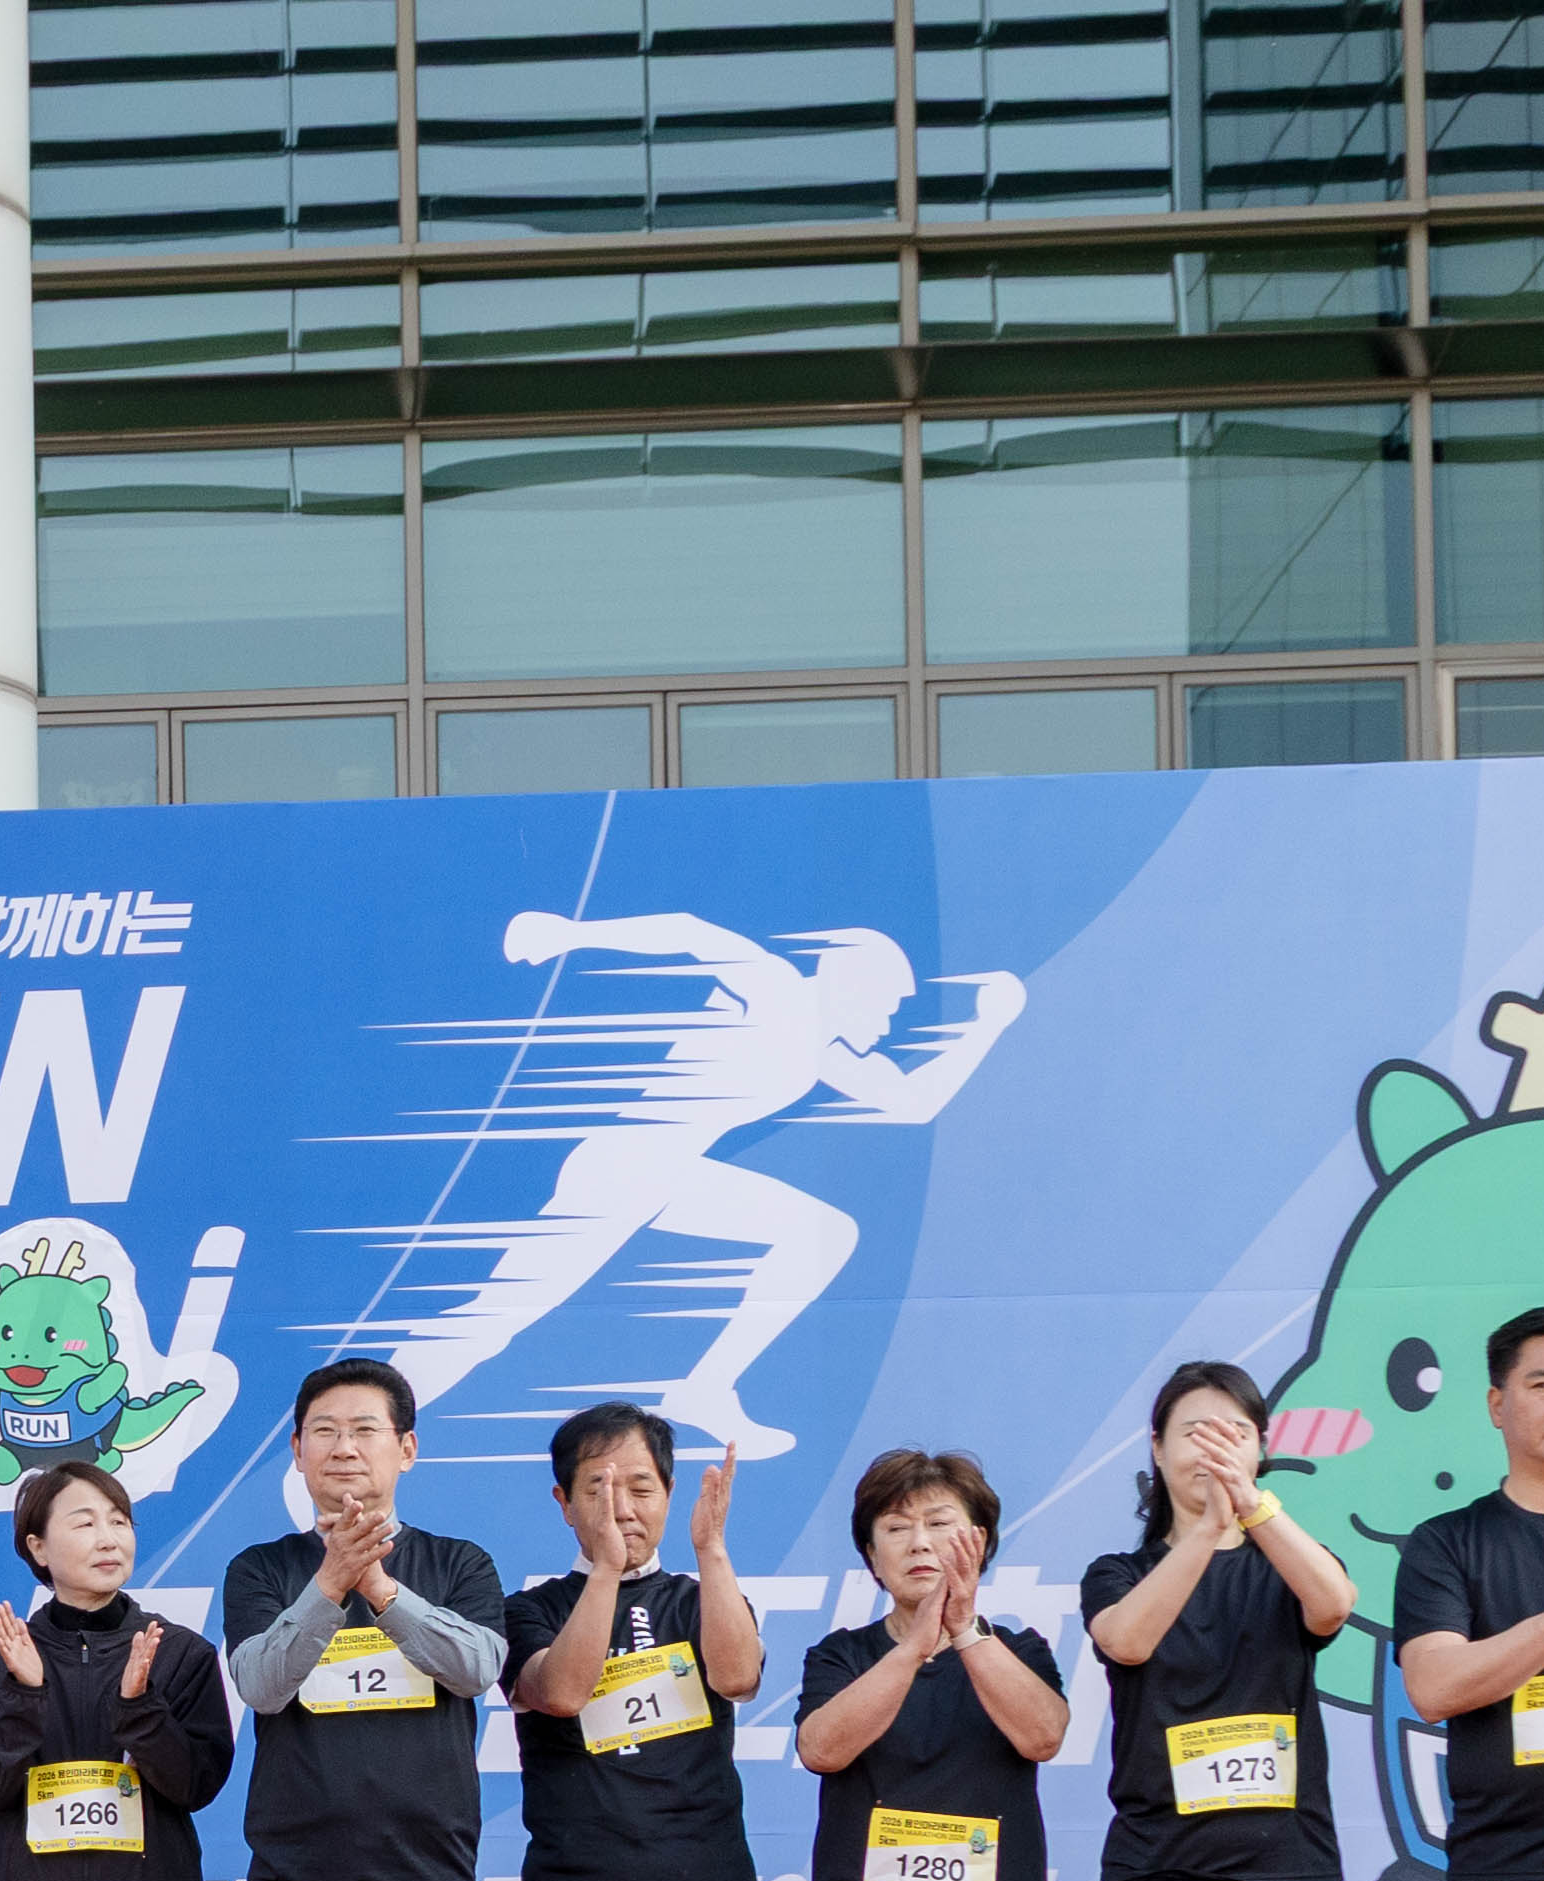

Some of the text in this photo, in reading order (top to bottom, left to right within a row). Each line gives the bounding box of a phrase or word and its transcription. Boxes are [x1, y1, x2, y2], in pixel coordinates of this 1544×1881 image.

[9, 1416, 60, 1438] RUN
[348, 1669, 387, 1694] 12
[625, 1692, 661, 1725] 21
[1208, 1756, 1277, 1784] 1273
[37, 1791, 55, 1801] 5km
[55, 1801, 118, 1827] 1266
[896, 1854, 965, 1881] 1280
